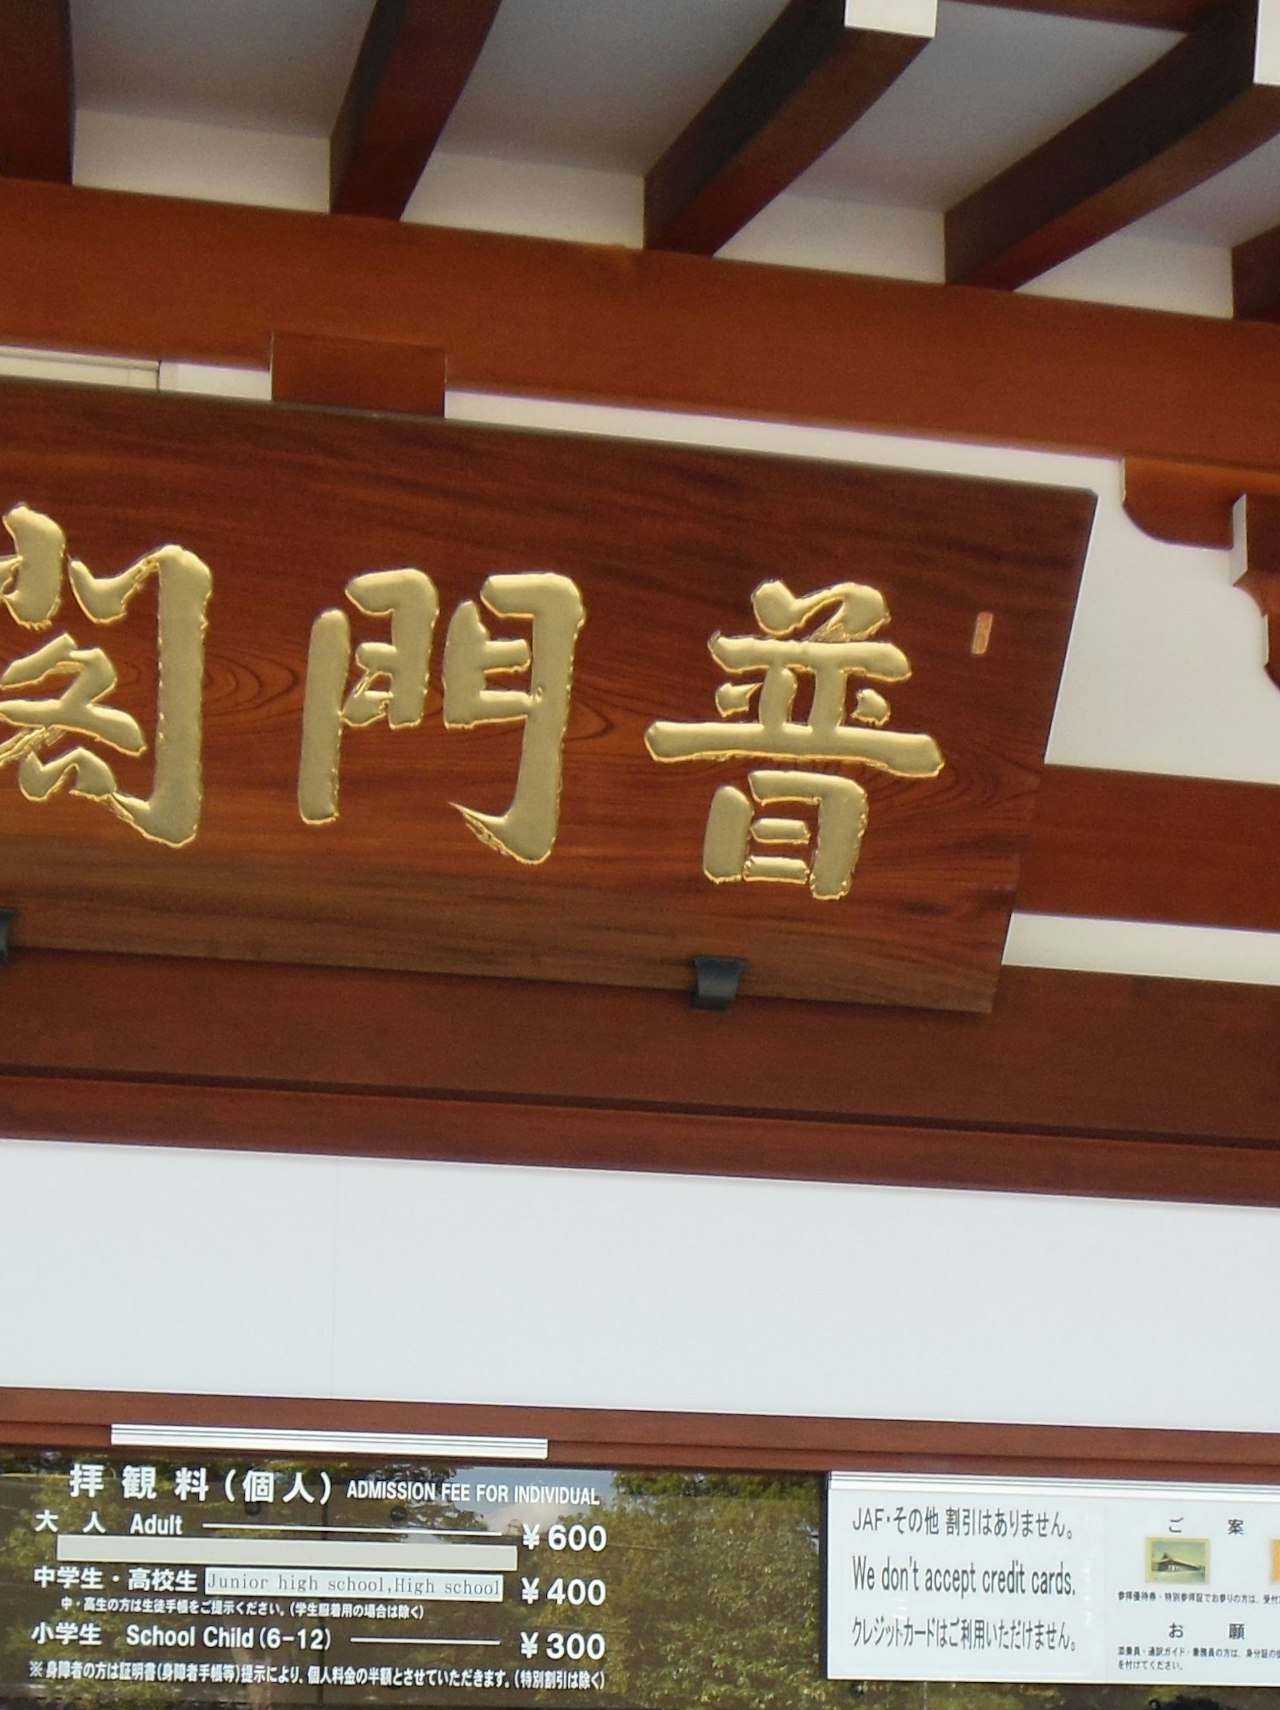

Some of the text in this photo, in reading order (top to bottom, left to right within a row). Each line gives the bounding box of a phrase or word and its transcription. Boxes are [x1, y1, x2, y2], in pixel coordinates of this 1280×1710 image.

[346, 1479, 436, 1501] ADMISSION
[441, 1483, 470, 1502] FEE
[476, 1484, 508, 1503] FOR
[514, 1485, 600, 1505] INDIVIDUAL
[130, 1513, 183, 1535] Adult
[946, 1507, 1072, 1539] 割引はありません。
[33, 1565, 198, 1592] 中学生・高校生
[207, 1572, 268, 1590] Junior
[278, 1574, 318, 1594] high
[444, 1579, 500, 1596] school
[852, 1555, 1075, 1599] We don't accept credit cards.
[31, 1621, 102, 1646] 小学生
[126, 1624, 195, 1647] School
[202, 1626, 254, 1649] Child
[852, 1616, 1075, 1652] クレジットカードはご利用いただけません。
